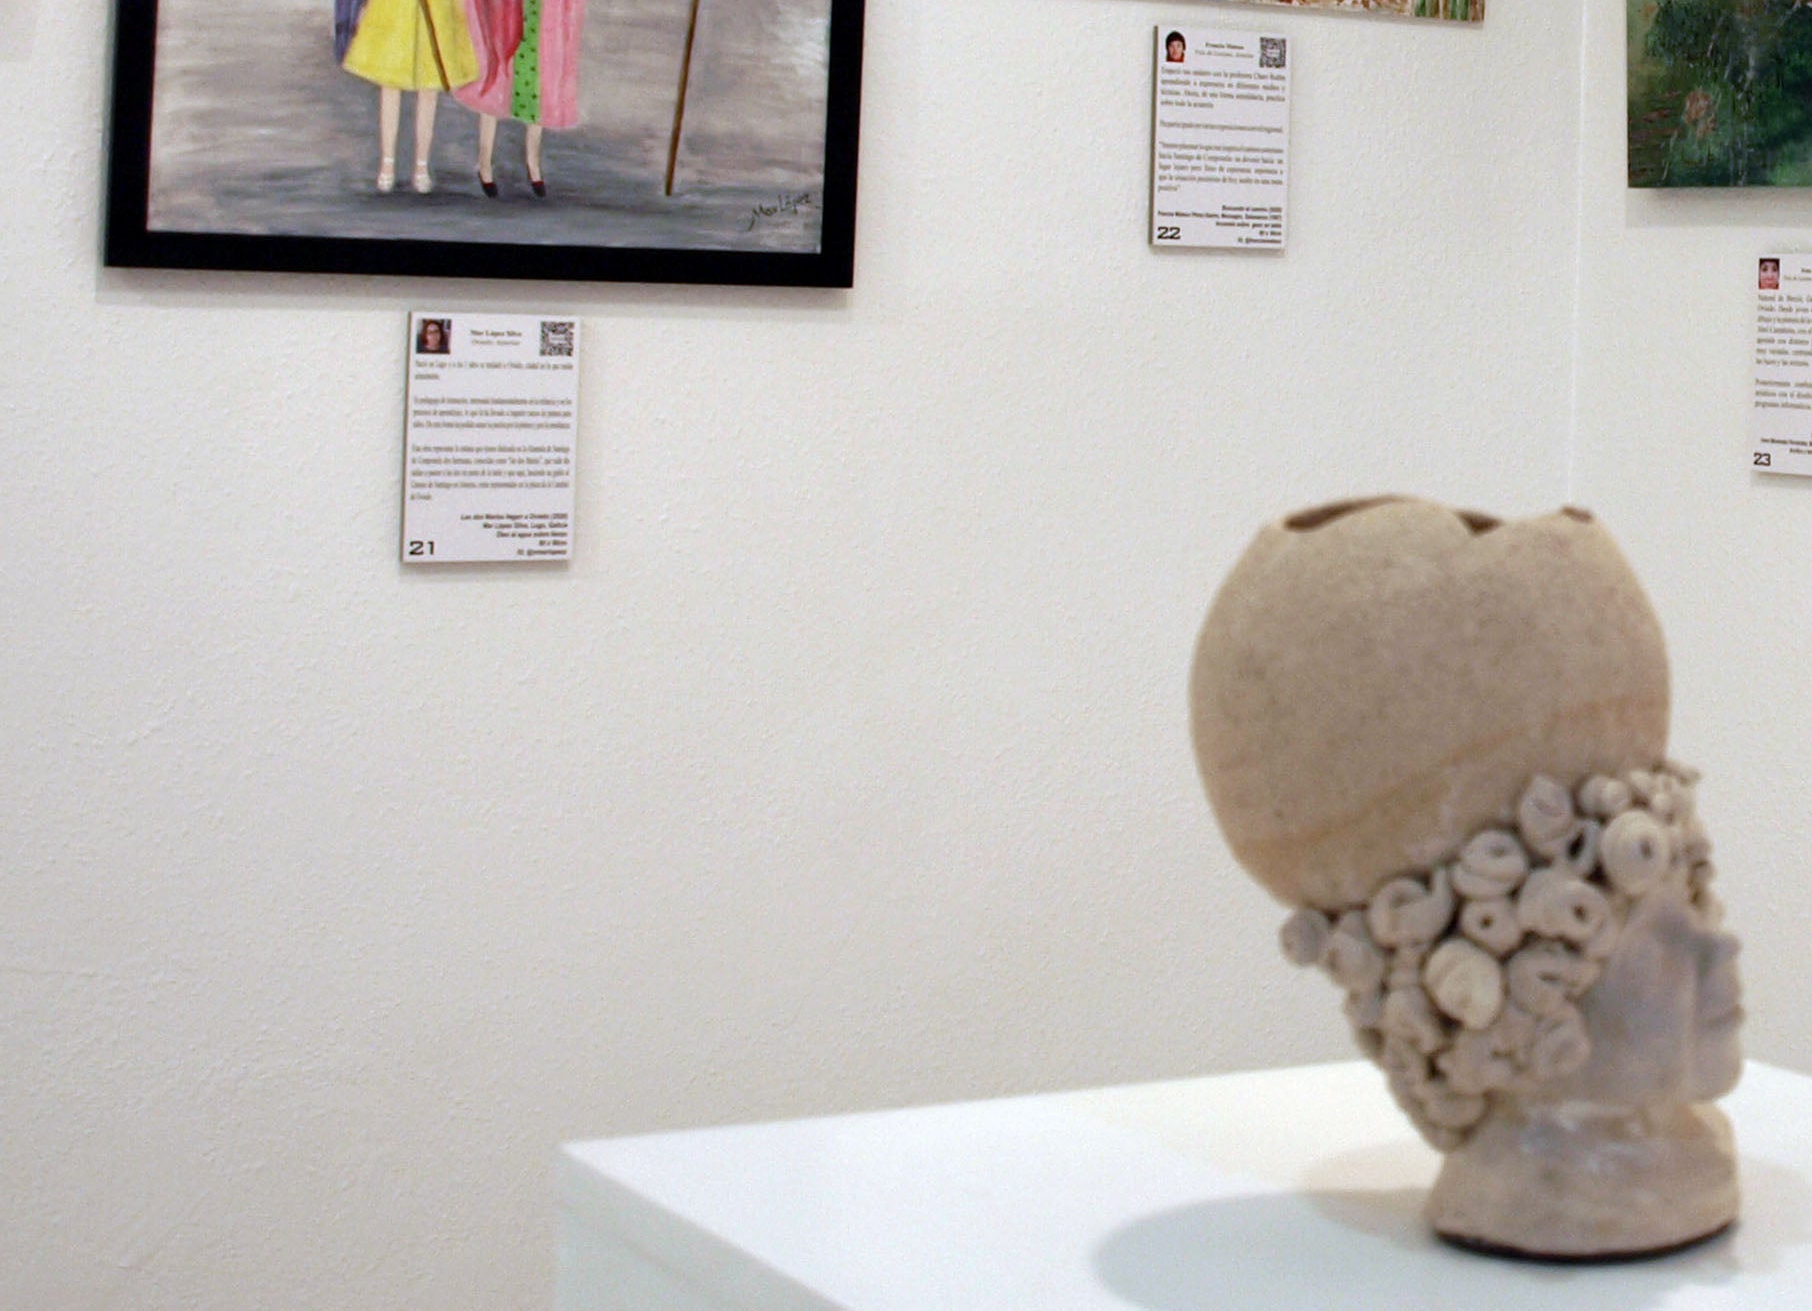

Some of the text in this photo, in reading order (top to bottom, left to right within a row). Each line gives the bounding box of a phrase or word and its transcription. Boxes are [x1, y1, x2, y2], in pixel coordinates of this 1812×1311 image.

[1157, 226, 1181, 240] 22
[1753, 452, 1771, 466] 23
[409, 541, 434, 555] 21
